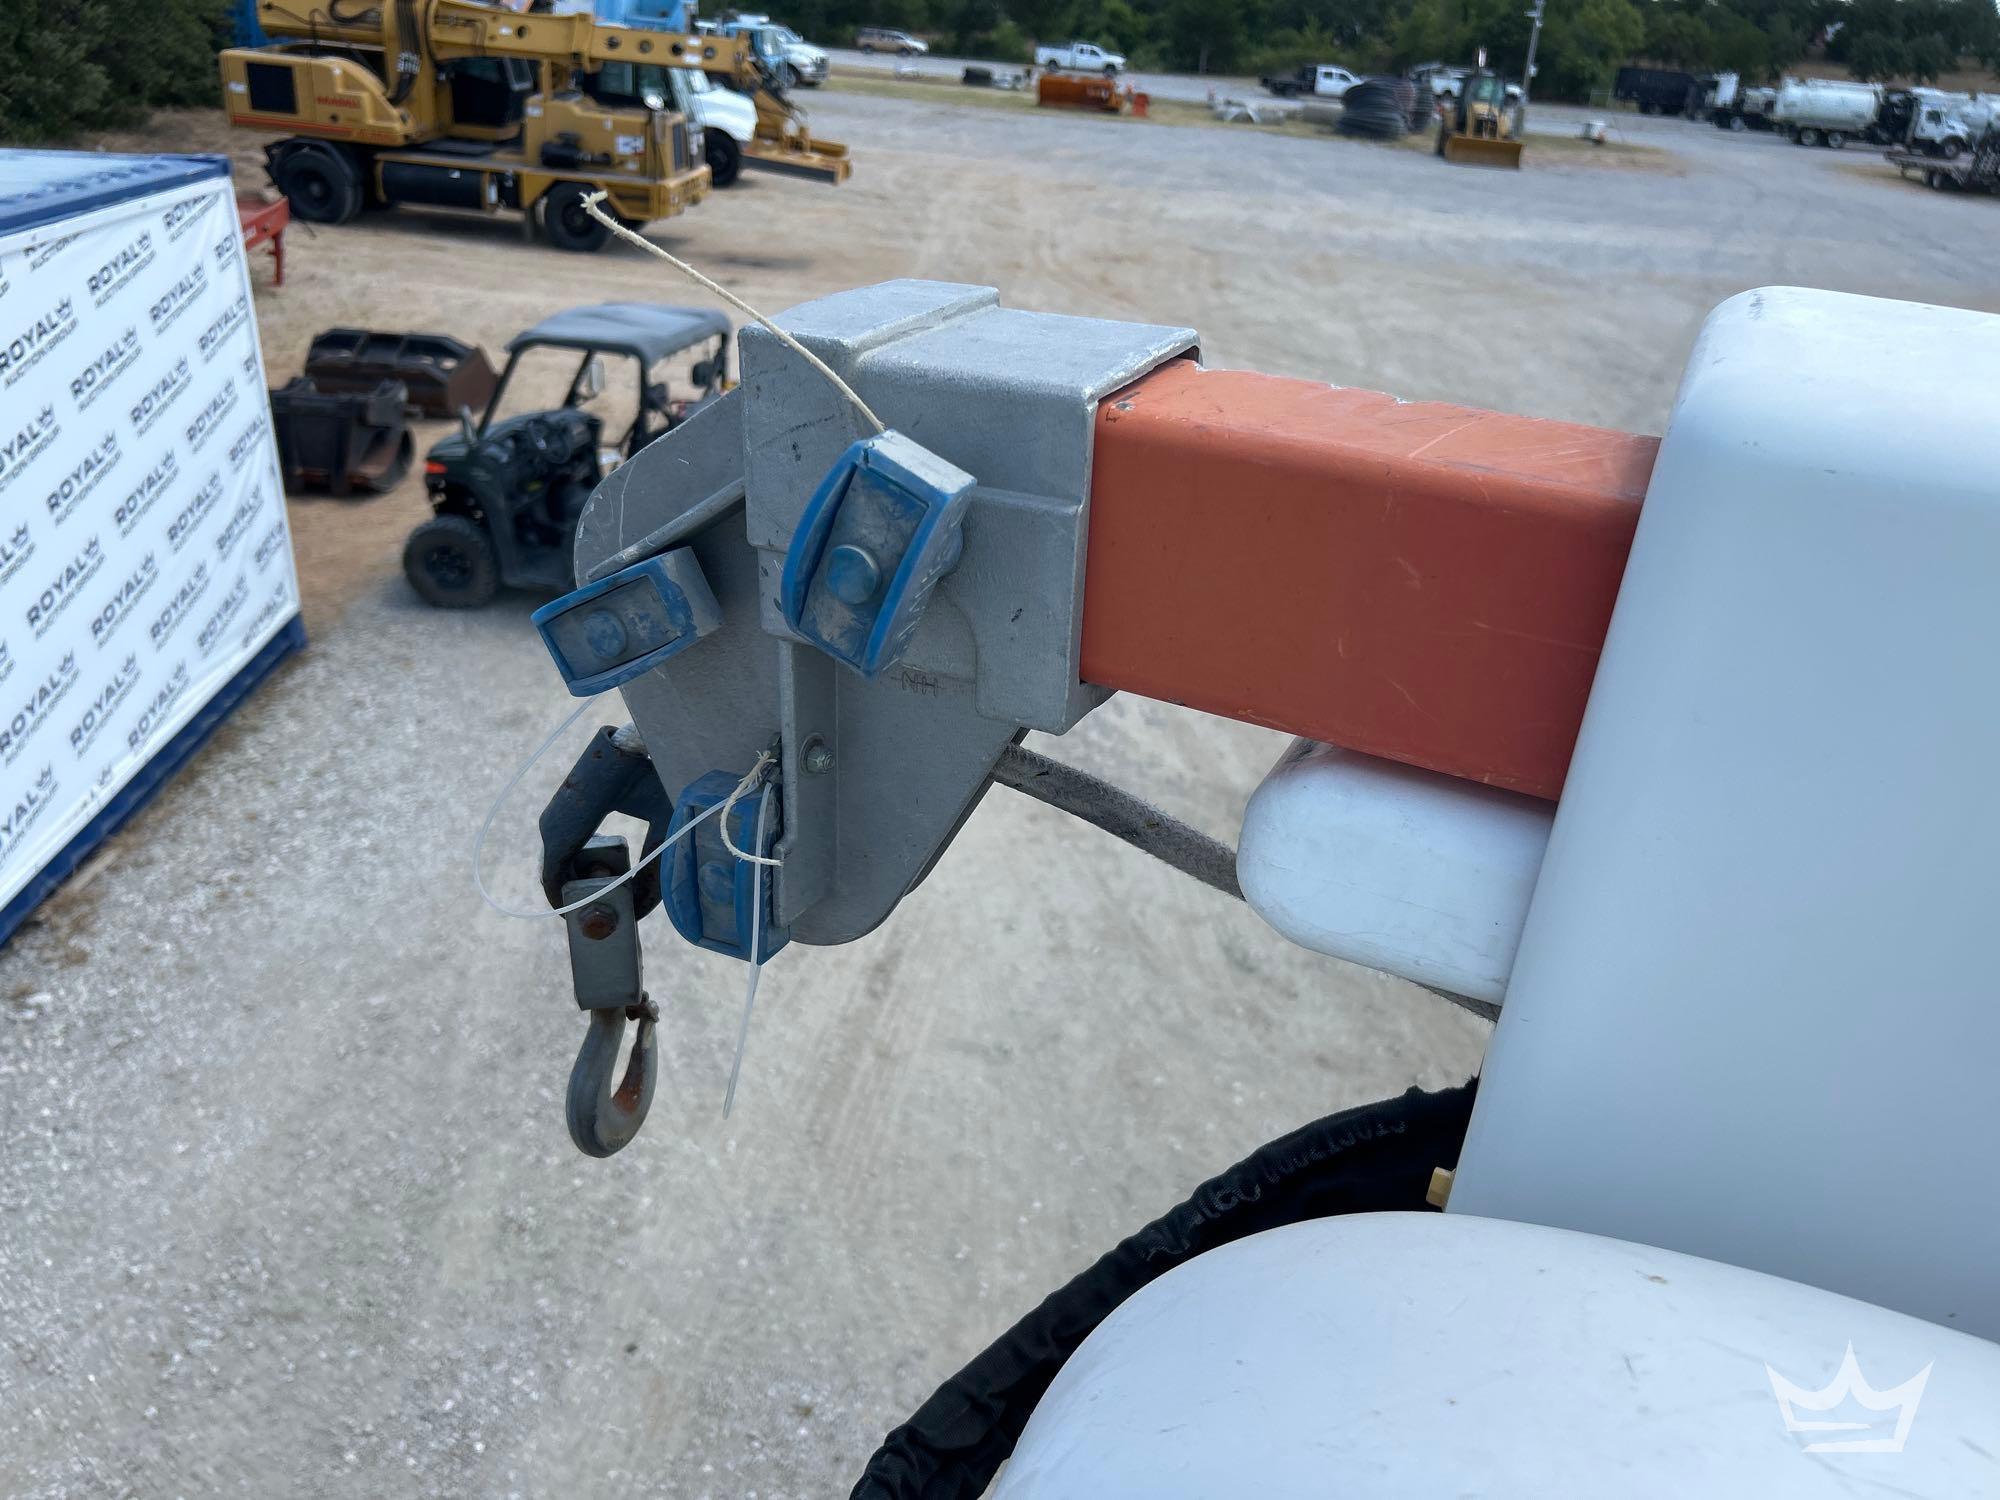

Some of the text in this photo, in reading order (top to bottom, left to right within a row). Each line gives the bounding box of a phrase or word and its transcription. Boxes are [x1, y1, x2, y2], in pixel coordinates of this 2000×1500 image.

[87, 243, 139, 295] ROYAL
[149, 274, 194, 324] ROYAL
[70, 342, 124, 401] ROYAL
[130, 369, 177, 427] ROYAL
[46, 447, 104, 515] ROYAL
[114, 467, 163, 528] ROYAL
[168, 485, 210, 545] ROYAL
[27, 553, 88, 628] ROYAL
[92, 570, 143, 640] ROYAL
[150, 578, 196, 642] ROYAL
[0, 673, 61, 757] ROYAL
[70, 673, 125, 749] ROYAL
[127, 681, 176, 750] ROYAL
